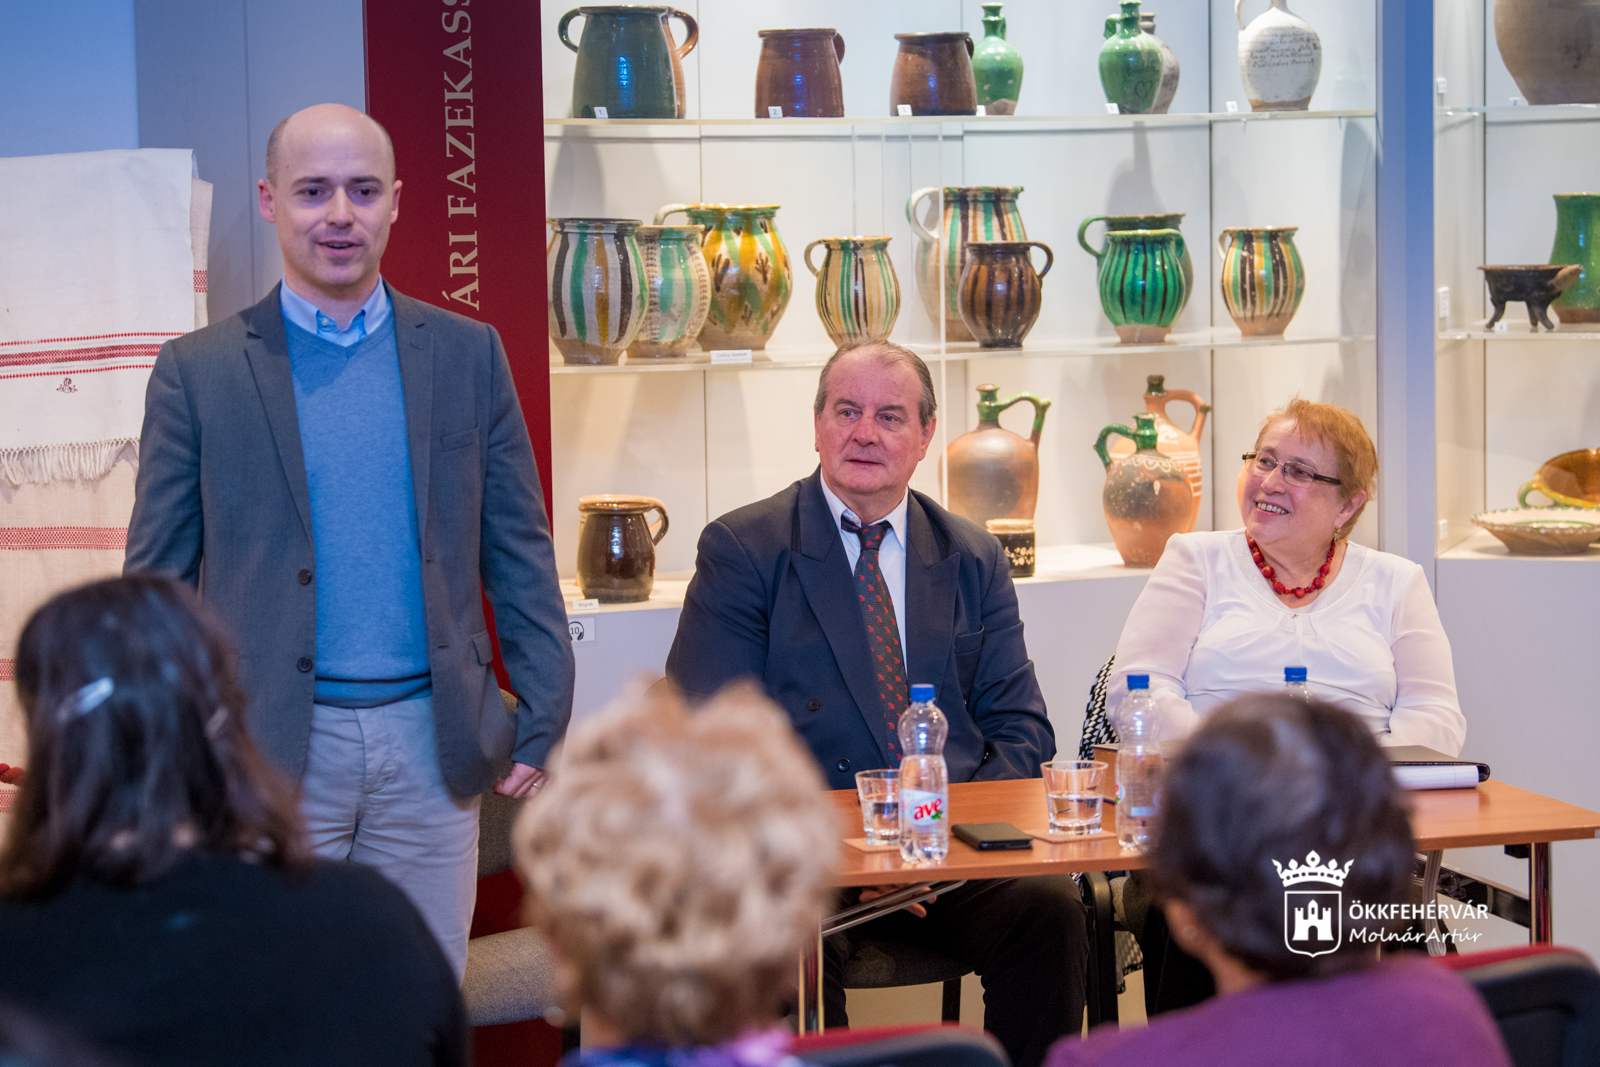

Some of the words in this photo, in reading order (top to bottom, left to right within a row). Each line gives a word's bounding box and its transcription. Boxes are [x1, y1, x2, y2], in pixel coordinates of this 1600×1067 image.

[441, 0, 477, 218] FAZEKAS
[570, 626, 580, 635] 10
[913, 797, 942, 820] ave
